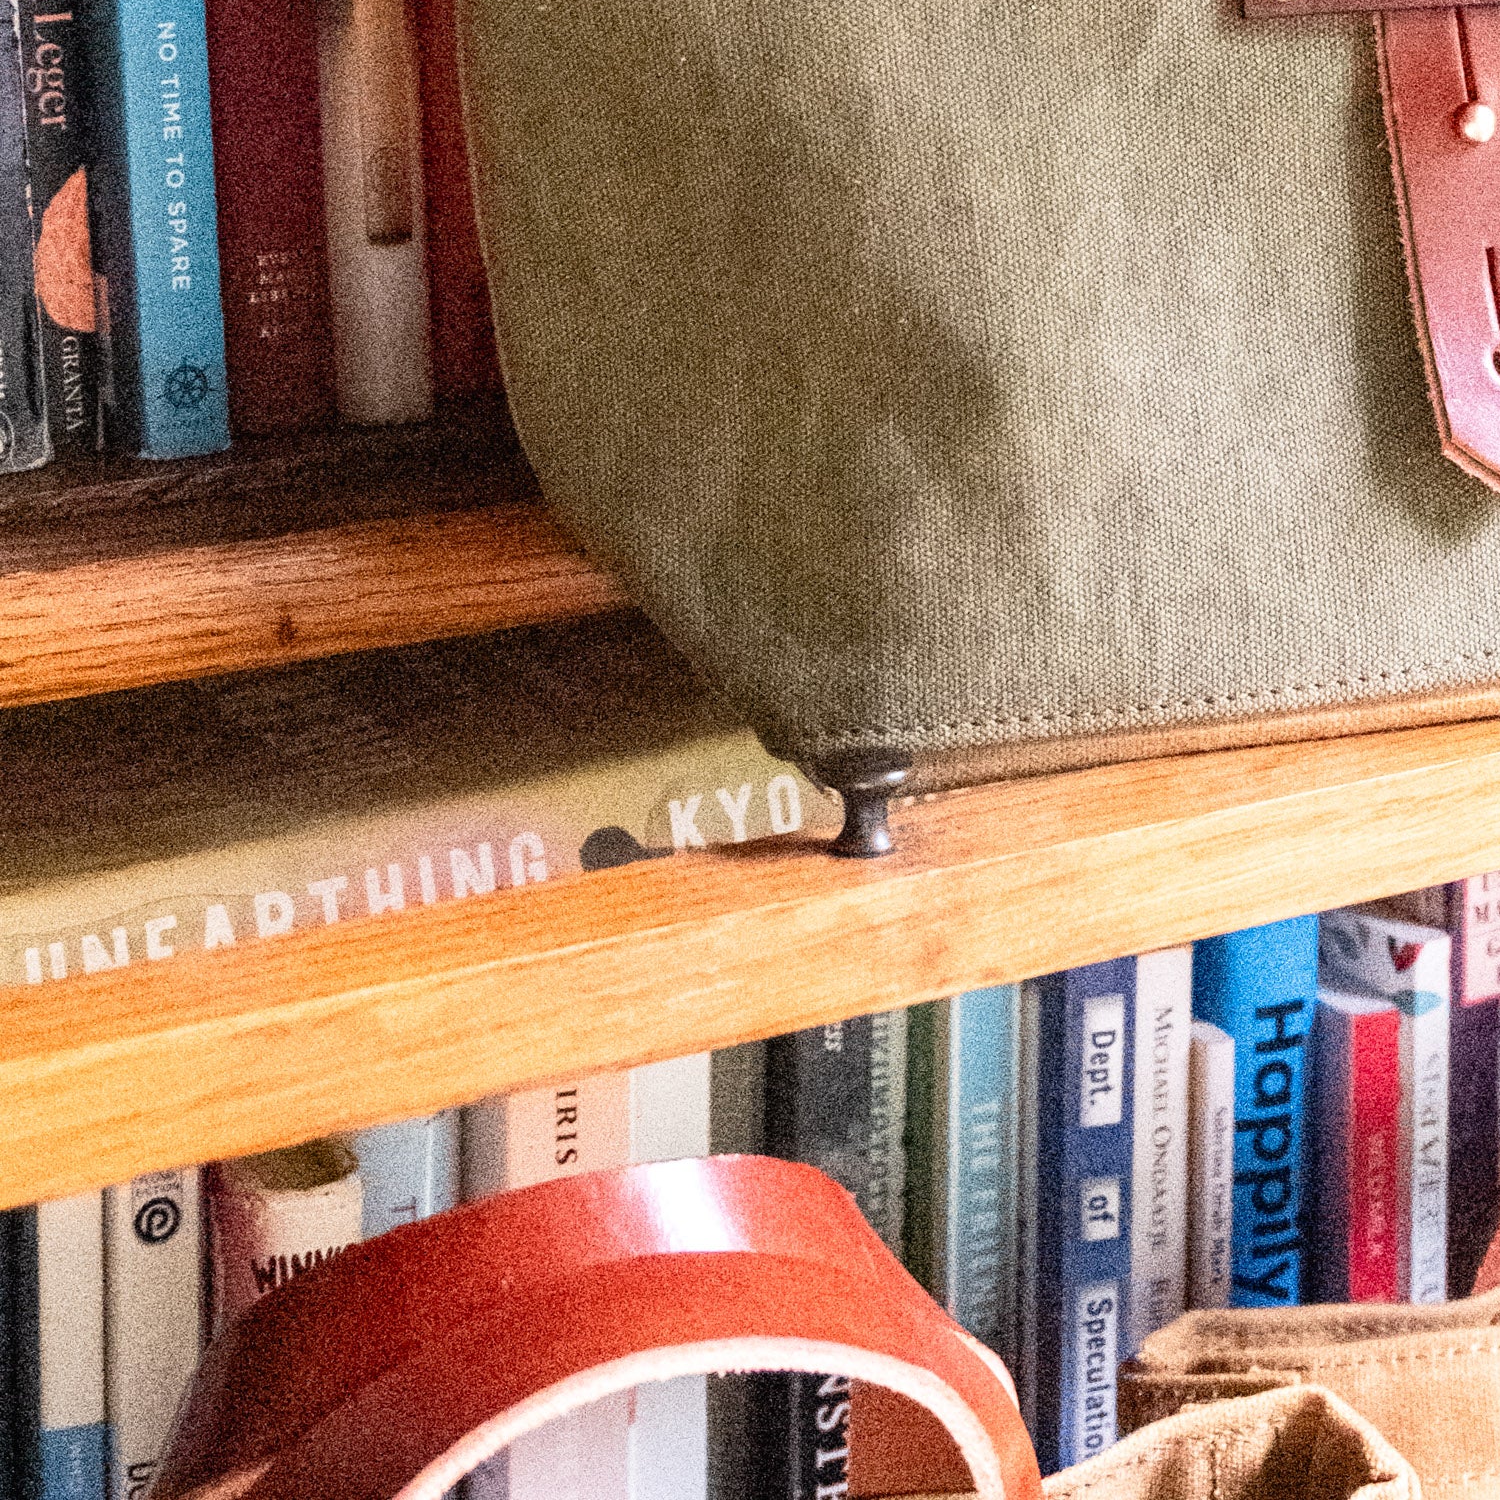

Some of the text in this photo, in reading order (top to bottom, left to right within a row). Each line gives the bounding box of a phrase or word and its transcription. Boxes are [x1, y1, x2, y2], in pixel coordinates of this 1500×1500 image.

[157, 21, 190, 293] NO TIME TO SPARE
[62, 336, 86, 431] GRANTA
[24, 774, 803, 986] UNEARTHING KYO
[1088, 1028, 1115, 1105] Dept.
[1150, 1007, 1175, 1114] MICHAEL
[555, 1089, 577, 1167] IRIS
[1237, 999, 1302, 1301] Happily
[1091, 1192, 1110, 1224] of
